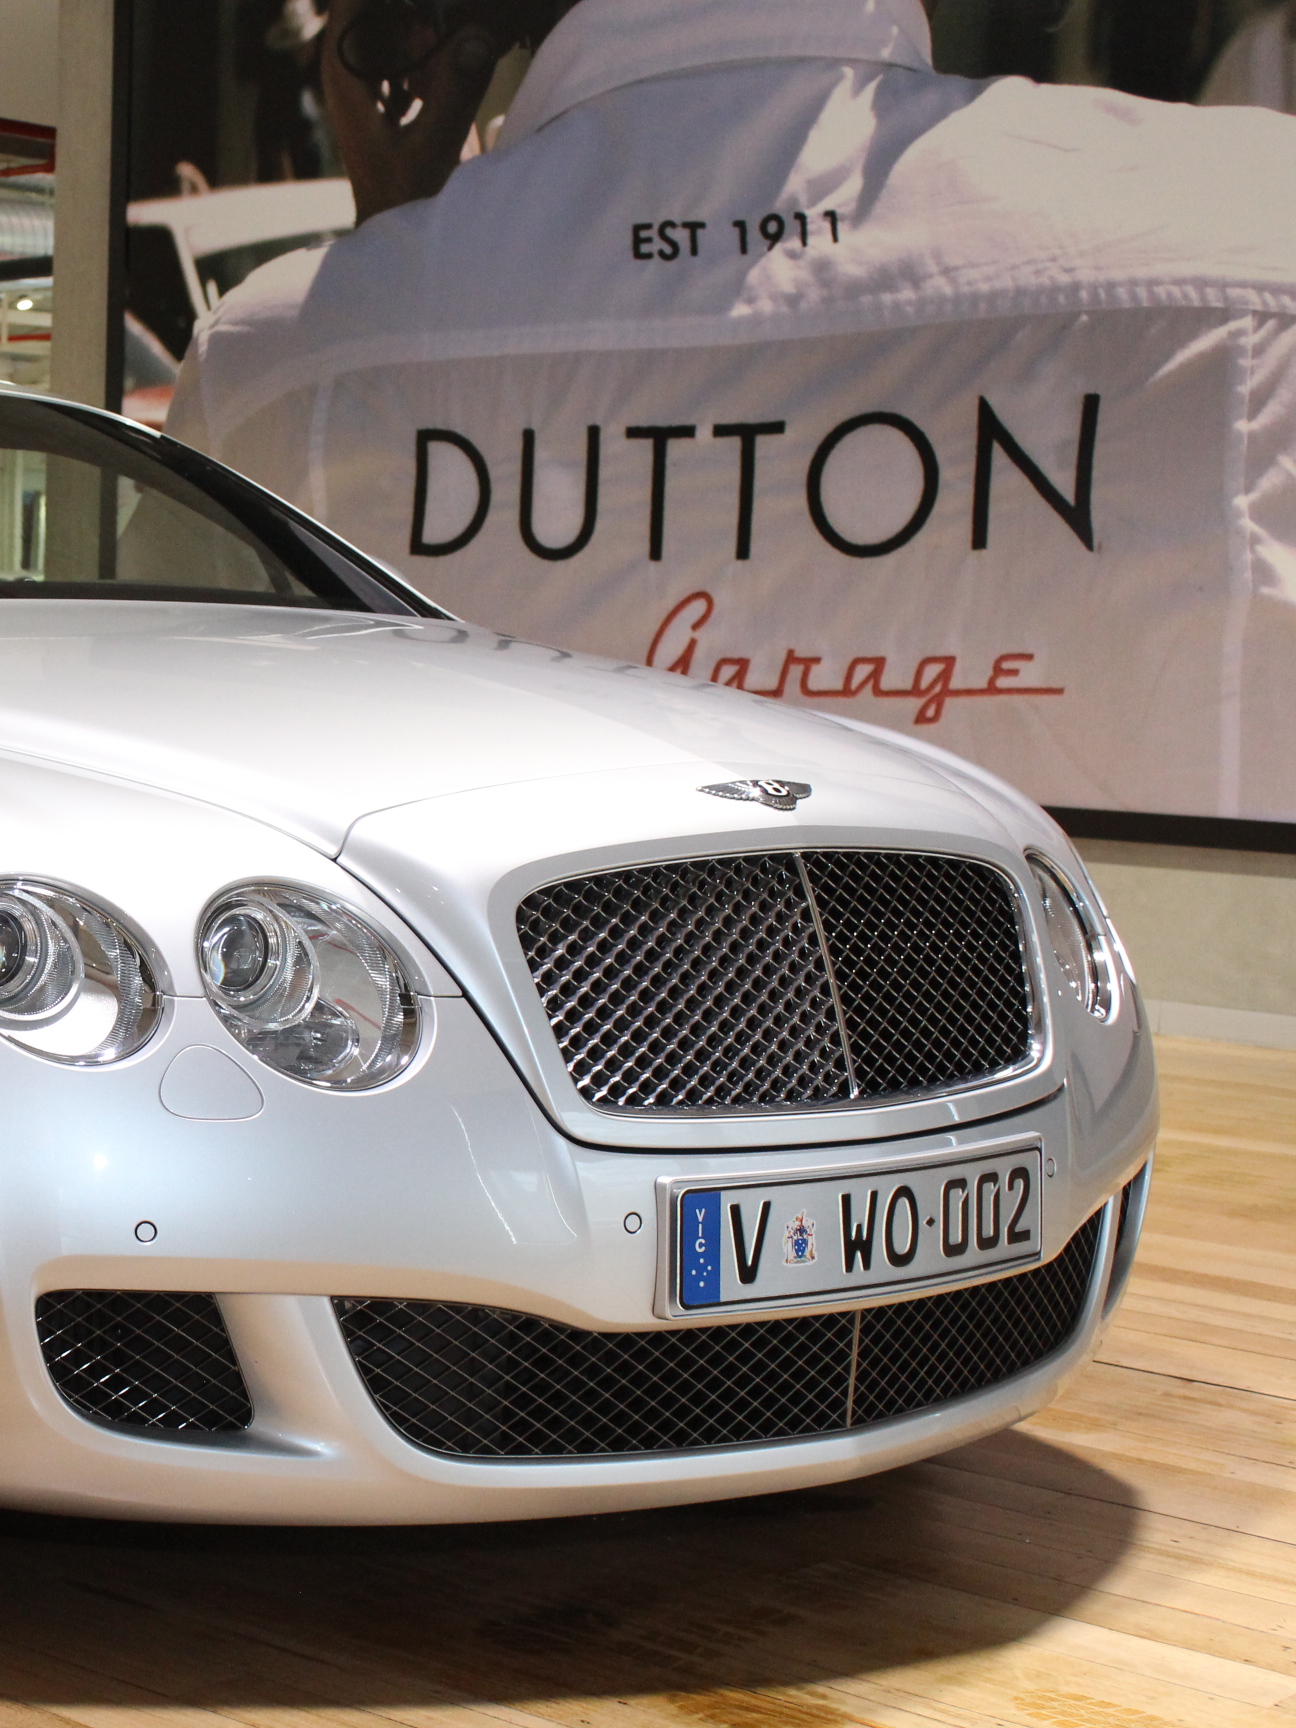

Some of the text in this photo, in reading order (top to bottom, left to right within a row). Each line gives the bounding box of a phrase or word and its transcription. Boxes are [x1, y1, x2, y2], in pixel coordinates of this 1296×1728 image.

[632, 209, 840, 261] EST 1911
[409, 393, 1101, 562] DUTTON
[645, 590, 1065, 726] Garage
[695, 1208, 706, 1253] VIC
[728, 1199, 772, 1285] V
